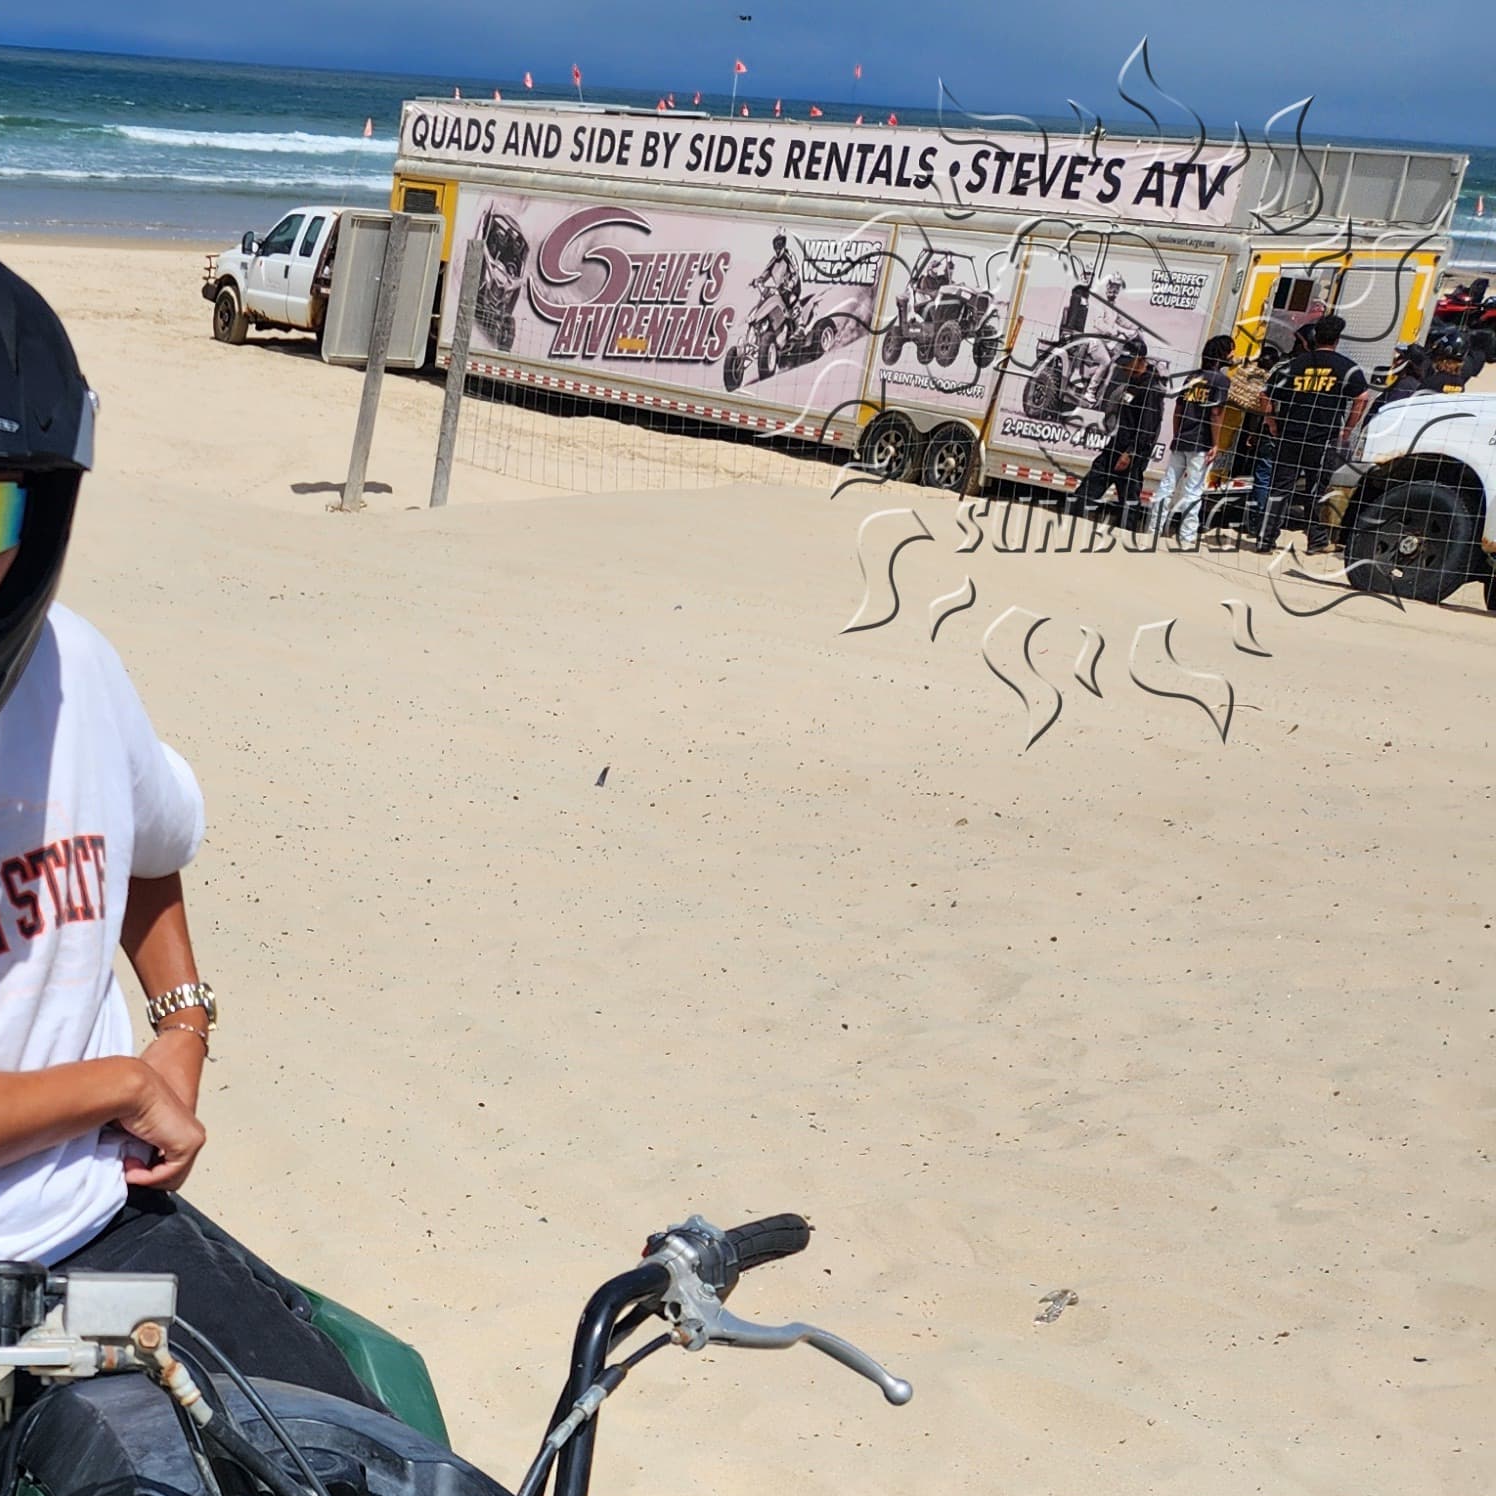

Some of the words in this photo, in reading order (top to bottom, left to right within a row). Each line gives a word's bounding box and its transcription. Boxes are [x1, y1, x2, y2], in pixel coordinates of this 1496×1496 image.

[411, 114, 496, 151] QUADS
[502, 121, 562, 159] AND
[569, 125, 634, 166] SIDE
[640, 131, 682, 169] BY
[685, 132, 776, 178] SIDES
[783, 139, 939, 190] RENTALS
[965, 149, 1127, 204] STEVE'S
[1132, 160, 1232, 211] ATV
[803, 261, 878, 284] WELCOME
[1171, 272, 1208, 287] PERFECT
[1152, 282, 1180, 296] QUAD
[1181, 285, 1201, 299] FOR
[550, 303, 616, 358] ATV
[604, 303, 736, 362] RENTALS
[1293, 376, 1337, 391] STAFF
[1001, 419, 1062, 442] 2-PERSON
